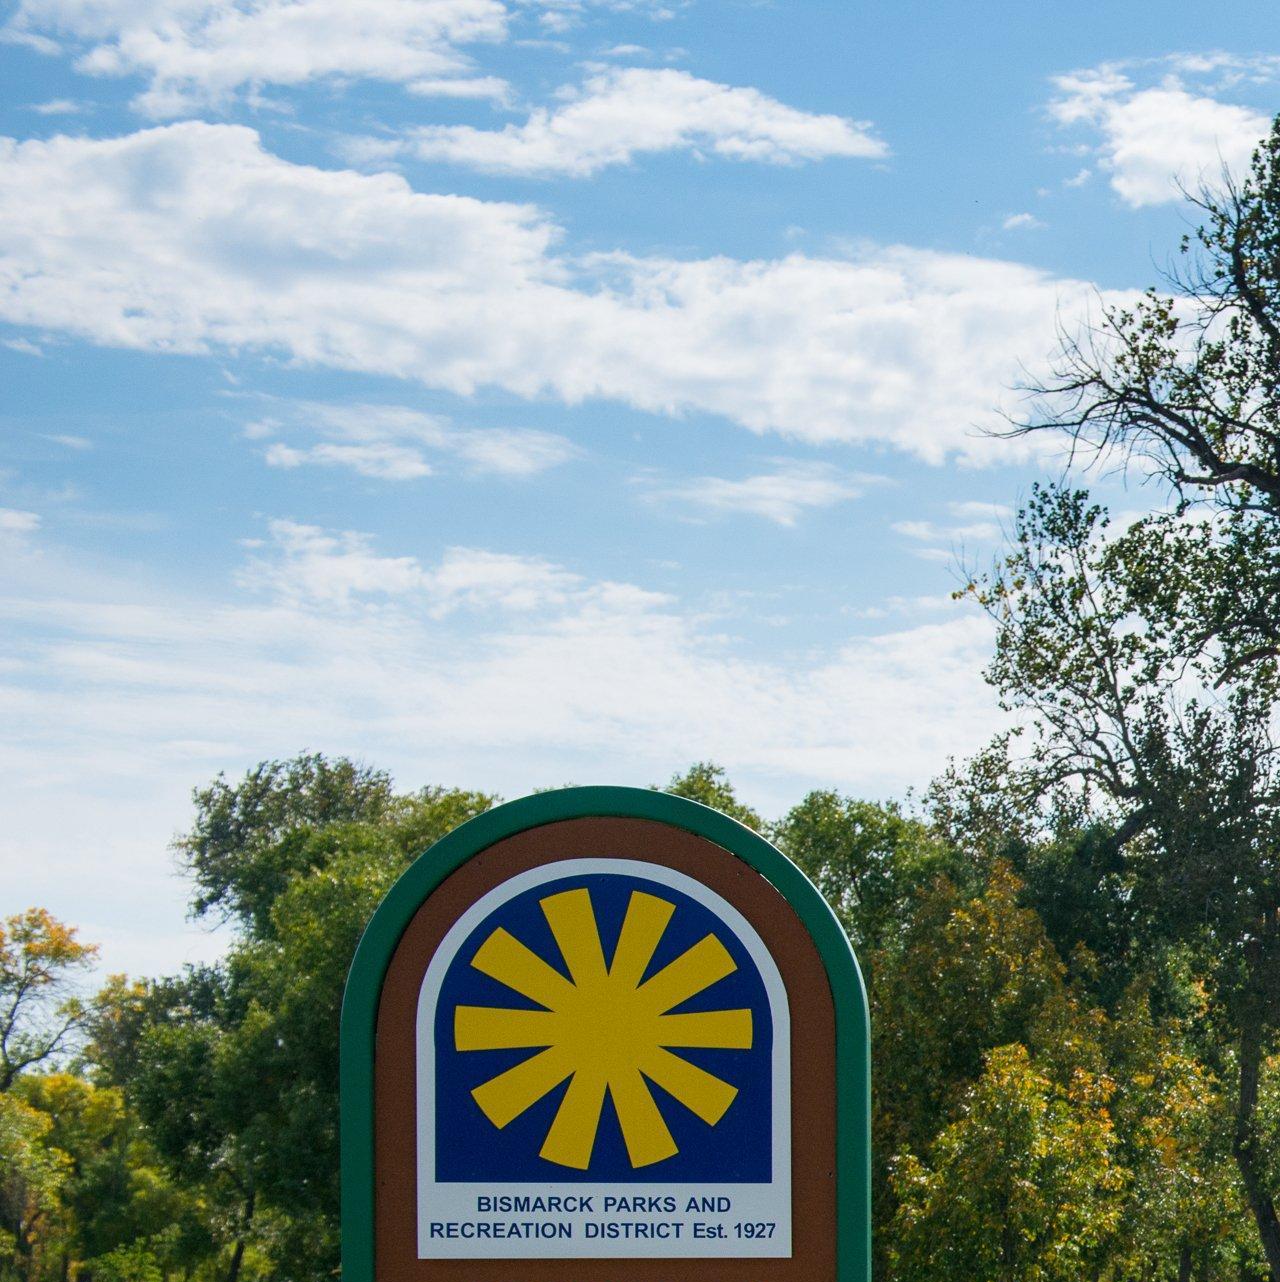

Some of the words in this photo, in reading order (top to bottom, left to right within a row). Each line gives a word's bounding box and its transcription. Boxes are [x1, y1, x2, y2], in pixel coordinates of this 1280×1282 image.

[477, 1196, 592, 1212] BISMARCK
[604, 1196, 676, 1212] PARKS
[685, 1197, 730, 1212] AND
[430, 1222, 571, 1238] RECREATION
[585, 1222, 684, 1238] DISTRICT
[693, 1222, 727, 1238] Est.
[734, 1222, 775, 1238] 1927
